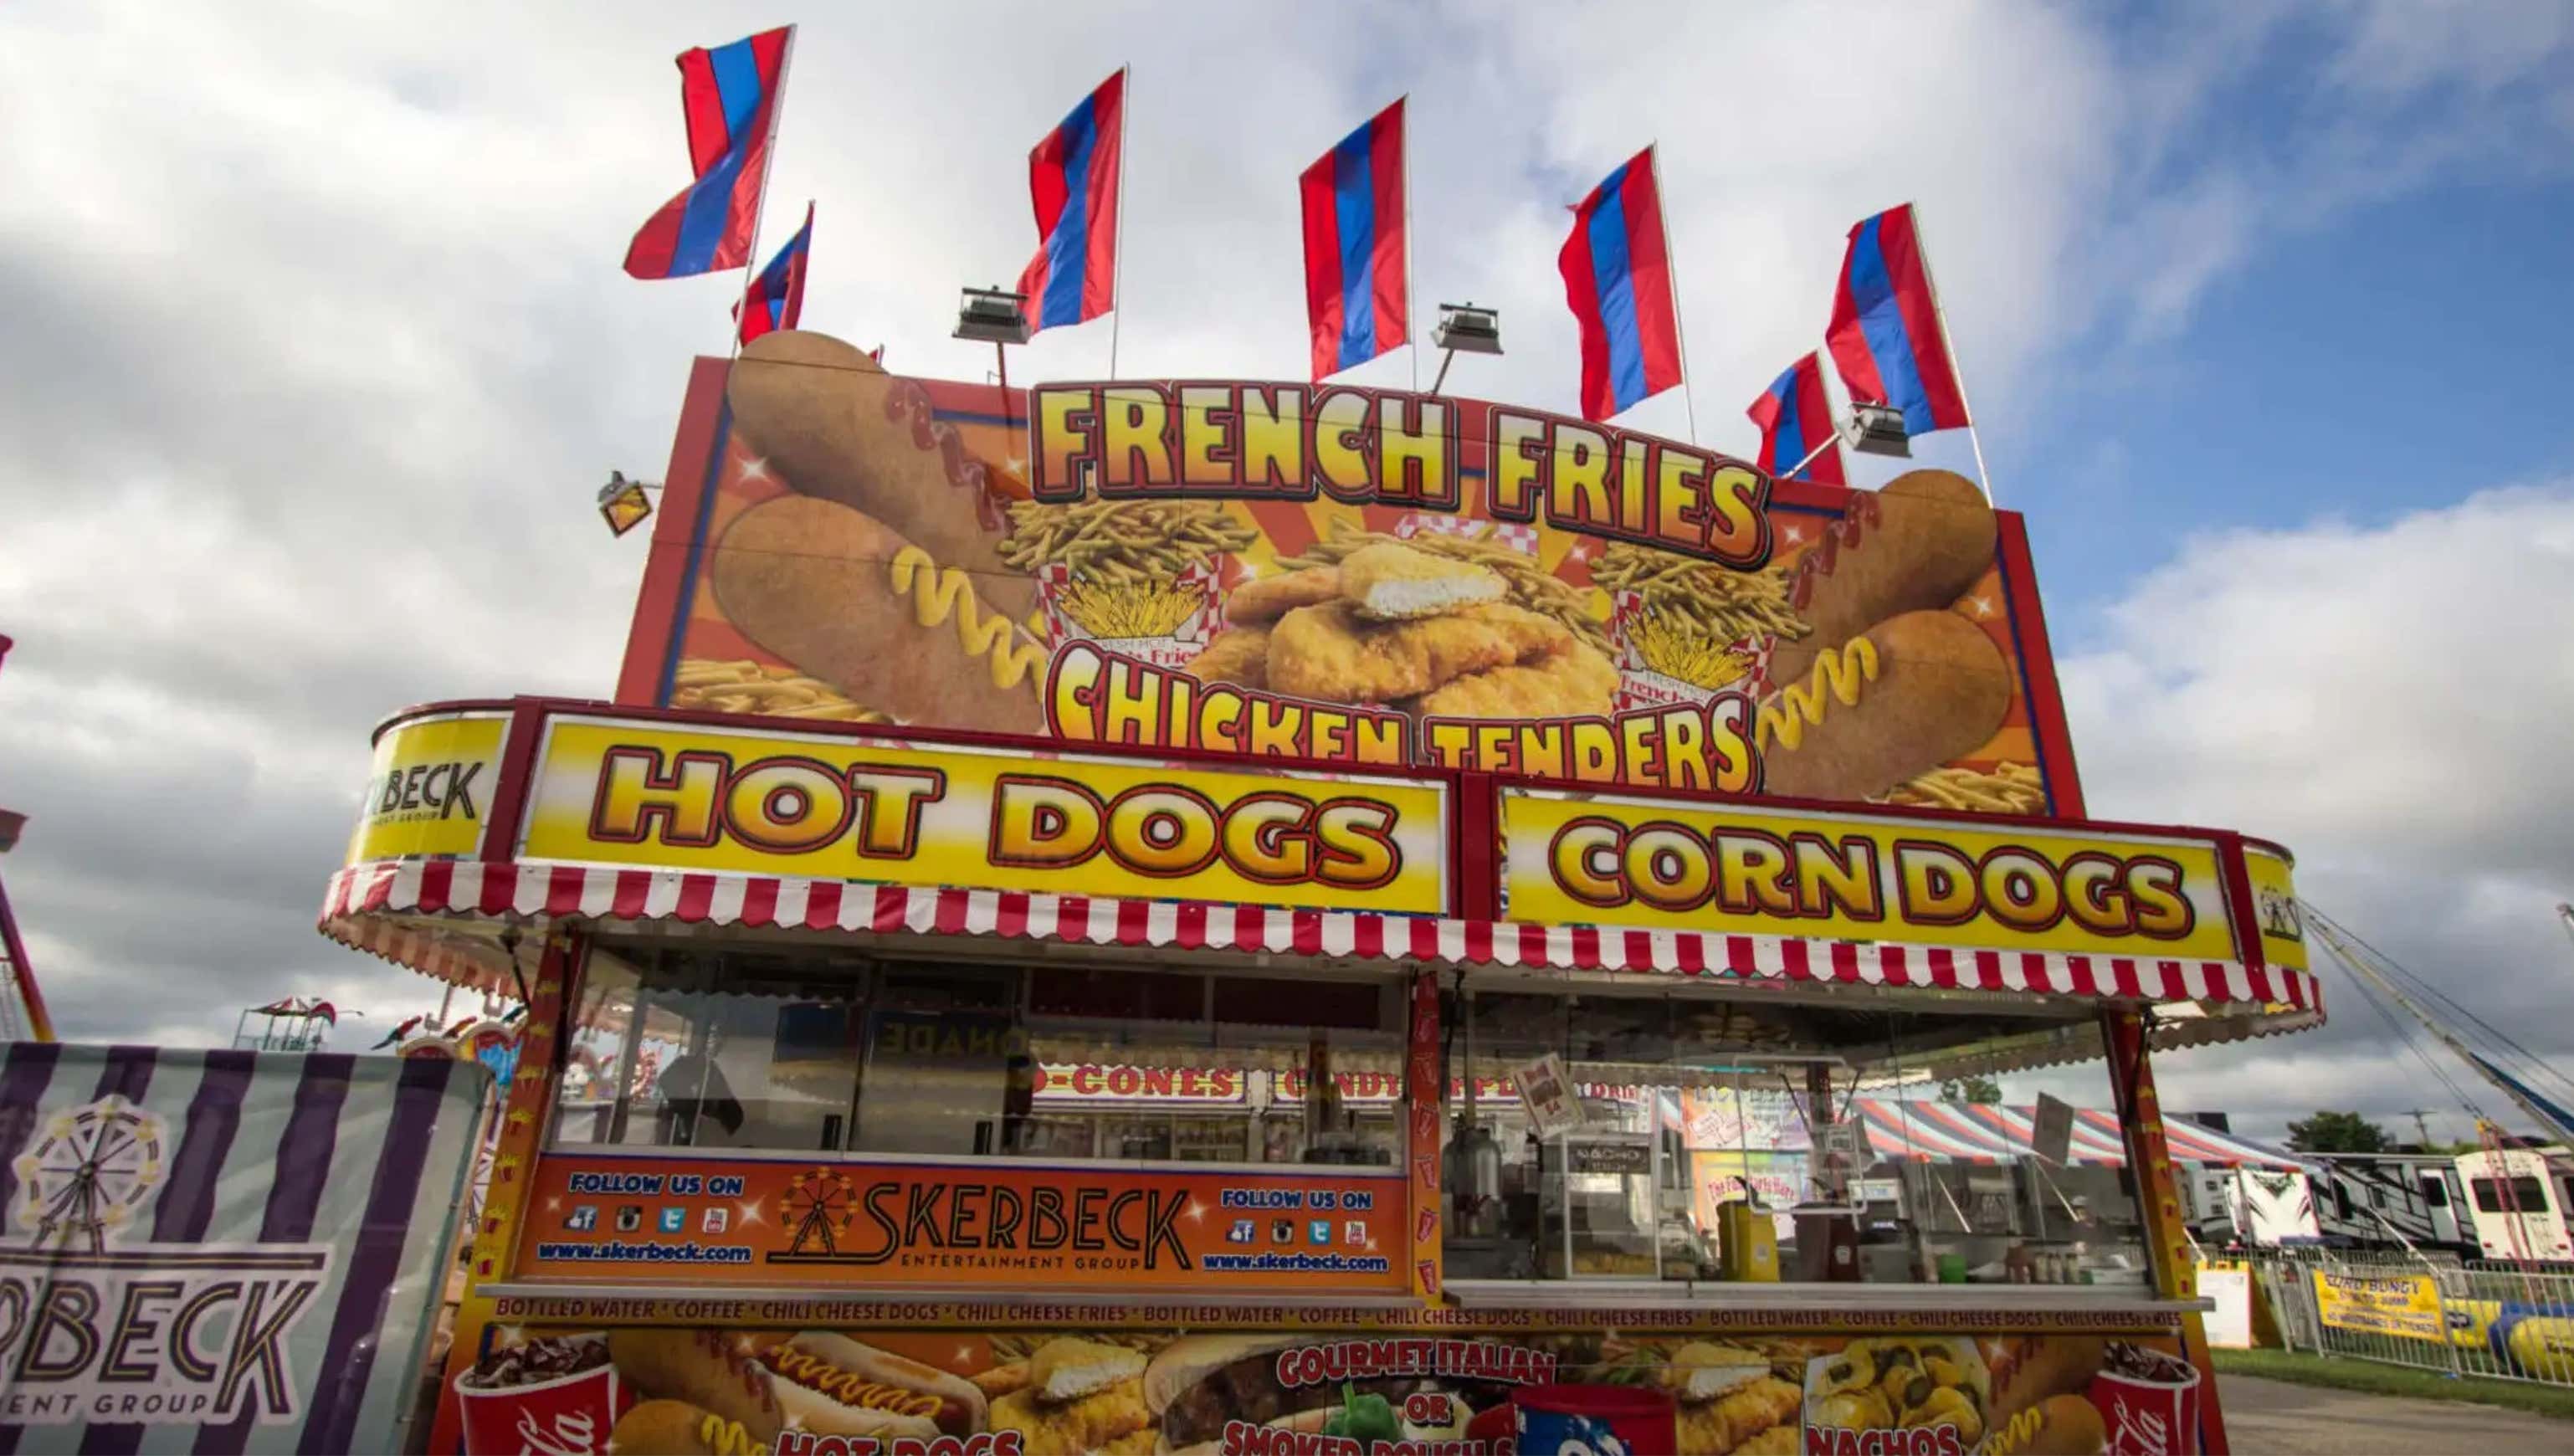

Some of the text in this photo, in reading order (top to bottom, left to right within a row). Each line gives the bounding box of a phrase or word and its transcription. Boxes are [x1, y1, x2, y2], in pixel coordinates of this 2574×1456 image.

[1031, 380, 1772, 569] FRENCH FRIES
[1046, 640, 1762, 795] CHICKEN TENDERS
[374, 761, 485, 821] BECK
[589, 744, 1402, 889] HOT DOGS
[1548, 816, 2195, 940] CORN DOGS
[1284, 1070, 1404, 1098] CNDY
[568, 1173, 745, 1196] FOLLOW US ON
[1222, 1189, 1372, 1209] FOLLOW US ON
[863, 1182, 1192, 1270] SKERBECK
[536, 1241, 751, 1264] www.skerbeck.com
[901, 1253, 1141, 1270] ENTERTAINMENT GROUP
[1202, 1252, 1389, 1272] www.skerbeck.com
[495, 1299, 584, 1316] BOTTLED
[590, 1300, 656, 1318] WATER
[674, 1301, 743, 1319] COFFEE
[761, 1302, 810, 1320] CHILI
[815, 1303, 884, 1320] CHEESE
[889, 1304, 939, 1320] DOGS
[956, 1304, 1003, 1321] CHILI
[1008, 1305, 1074, 1321] CHEESE
[1079, 1305, 1126, 1322] FRIES
[1144, 1306, 1221, 1322] BOTTLED
[1225, 1307, 1283, 1323] WATER
[1299, 1308, 1360, 1324] COFFEE
[1376, 1309, 1418, 1325] CHILI
[1423, 1309, 1484, 1325] CHEESE
[1486, 1310, 1531, 1325] DOGS
[1545, 1310, 1587, 1325] CHILI
[1591, 1310, 1649, 1325] CHEESE
[1651, 1310, 1693, 1325] FRIES
[1710, 1310, 1776, 1326] BOTTLED
[1780, 1311, 1831, 1326] WATER
[1843, 1311, 1897, 1326] COFFEE
[1949, 1311, 2002, 1326] CHEESE
[2005, 1312, 2043, 1327] DOGS
[1277, 1340, 1556, 1388] GOURMET ITALIAN
[0, 1393, 208, 1415] ENT GROUP
[1404, 1393, 1451, 1423] OR
[1222, 1420, 1364, 1456] SMOKED
[1806, 1423, 1961, 1456] NACHOS
